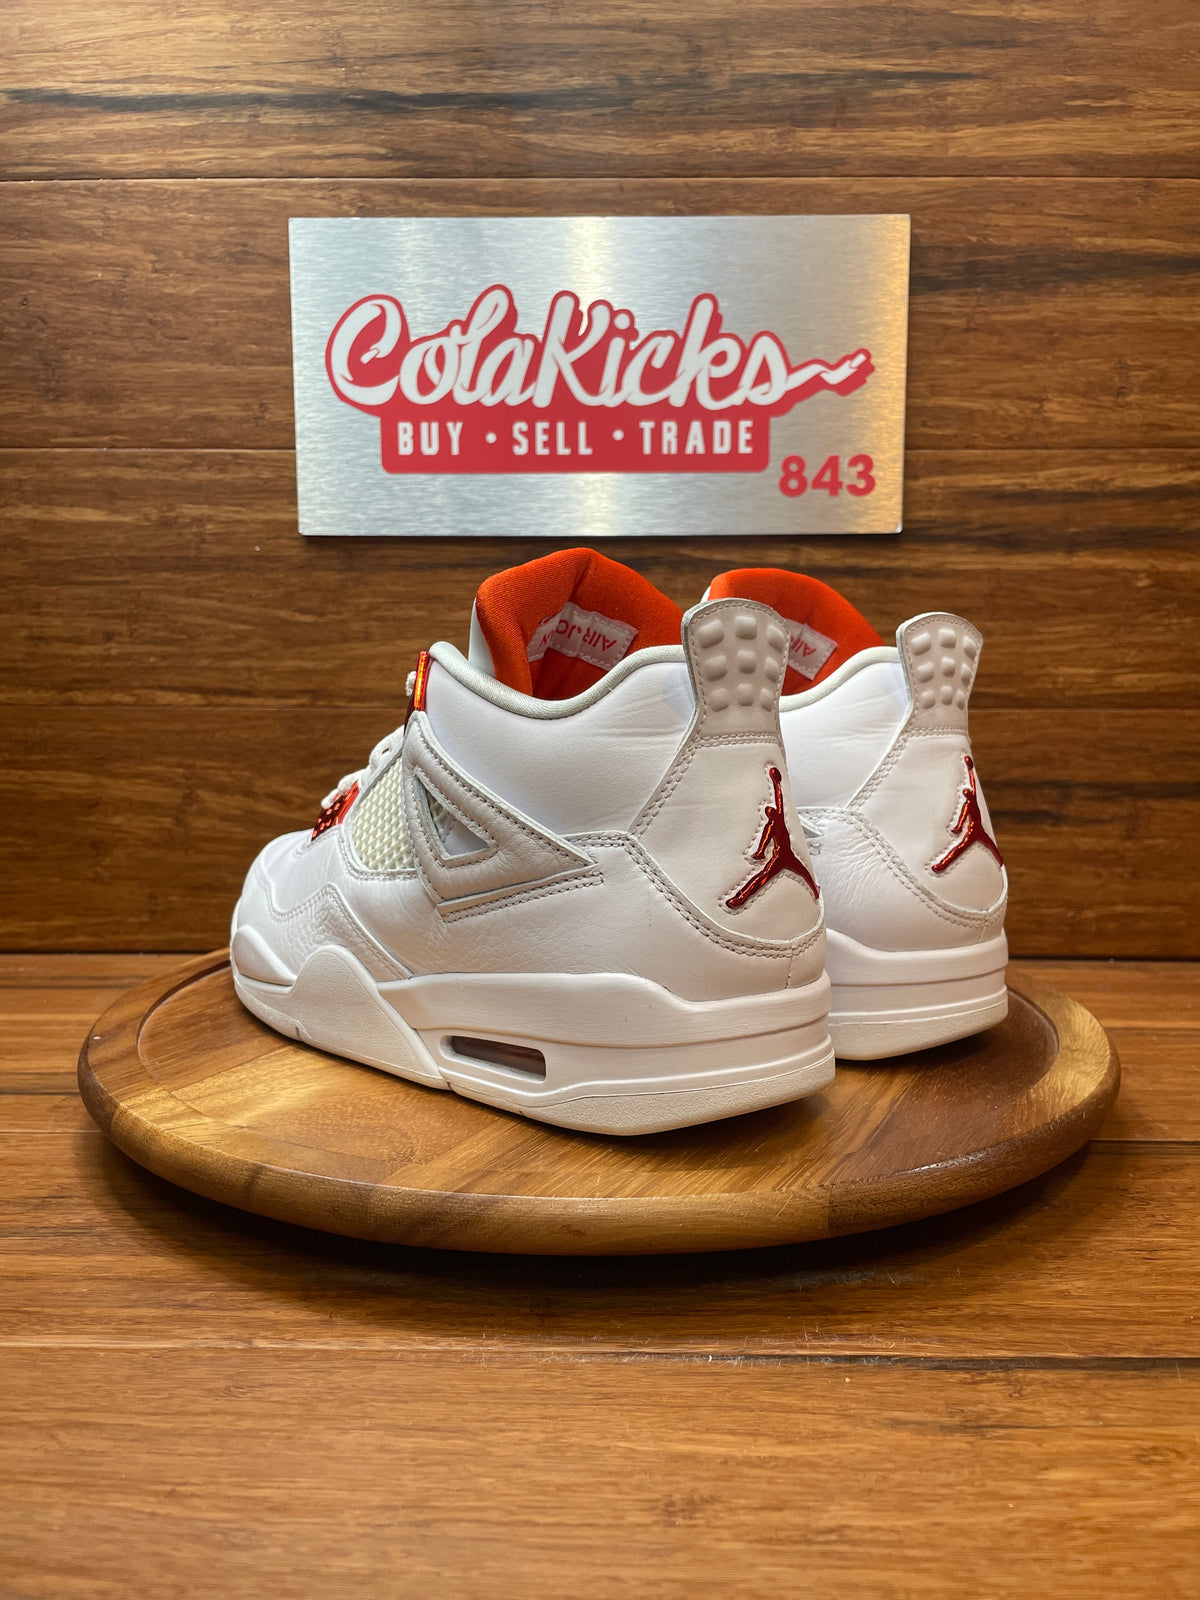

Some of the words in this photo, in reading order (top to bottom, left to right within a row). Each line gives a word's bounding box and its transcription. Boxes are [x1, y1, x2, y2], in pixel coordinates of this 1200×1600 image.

[330, 288, 867, 410] ColaKicks
[397, 421, 463, 456] BUY
[512, 421, 593, 456] SELL
[639, 419, 754, 455] TRADE
[778, 454, 876, 497] 843
